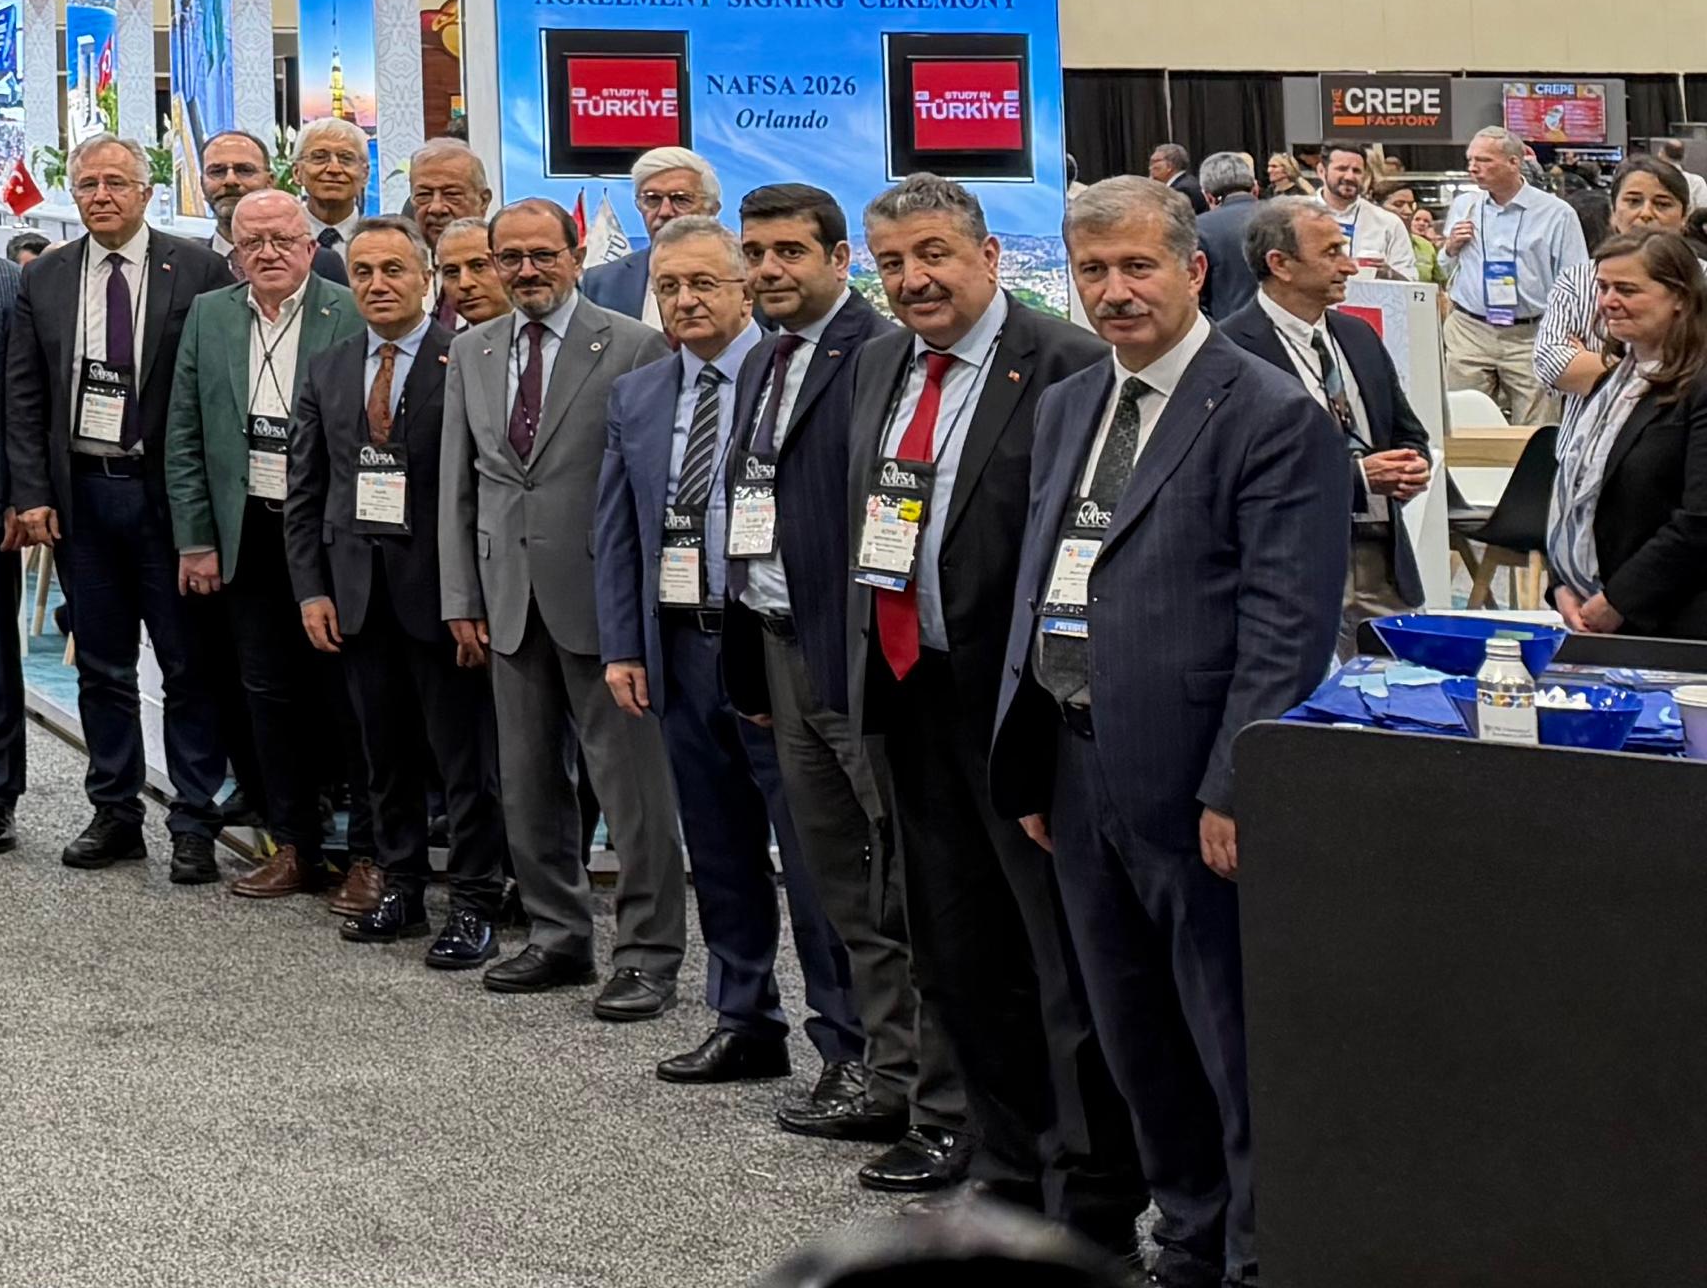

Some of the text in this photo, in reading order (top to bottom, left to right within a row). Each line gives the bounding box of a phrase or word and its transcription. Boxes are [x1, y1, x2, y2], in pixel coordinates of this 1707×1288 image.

[602, 88, 649, 98] STUDY IN
[707, 74, 857, 96] NAFSA 2026
[944, 91, 978, 99] STUDY
[1535, 83, 1575, 95] CREPE
[572, 96, 678, 117] TÜRKİYE
[915, 98, 1020, 120] TÜRKİYE
[1344, 88, 1441, 114] CREPE
[735, 107, 830, 129] Orlando
[1365, 115, 1439, 127] FACTORY
[1412, 291, 1426, 302] F2
[880, 469, 917, 489] NAFSA
